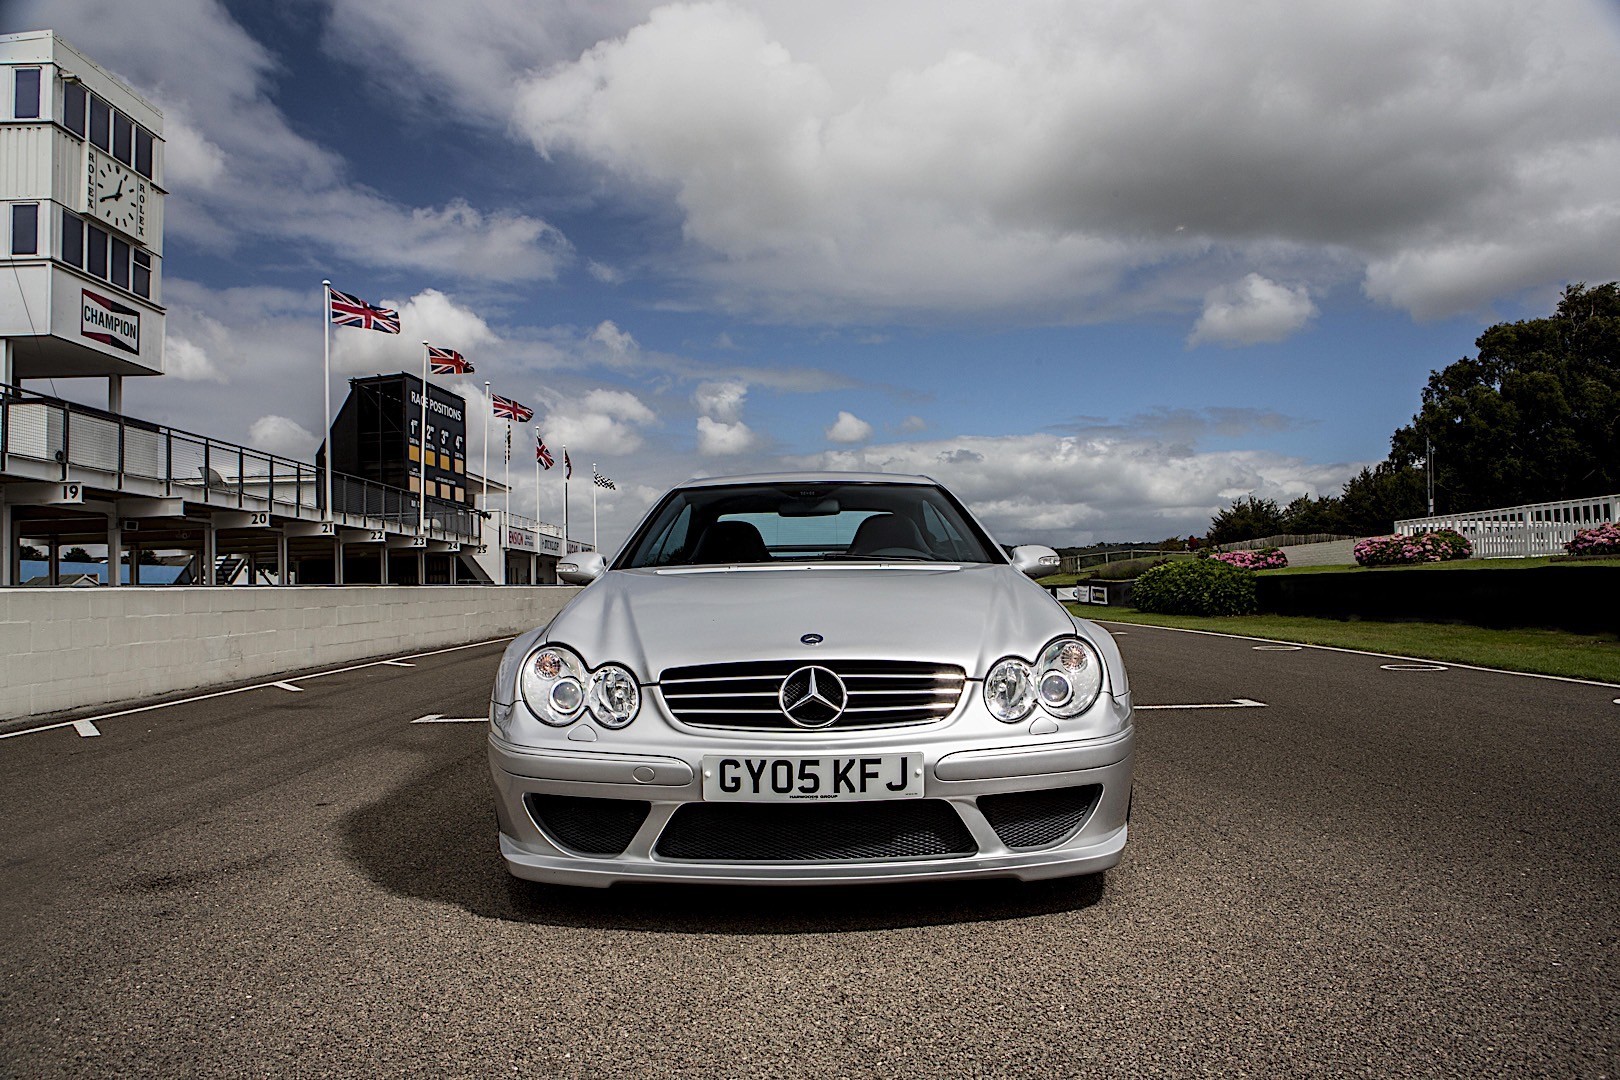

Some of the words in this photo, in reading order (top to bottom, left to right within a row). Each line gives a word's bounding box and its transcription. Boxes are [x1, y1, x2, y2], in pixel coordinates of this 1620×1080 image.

[84, 305, 137, 340] CHAMPION
[429, 399, 462, 421] POSITIONS
[63, 485, 79, 499] 19
[251, 513, 267, 525] 20
[322, 523, 333, 533] 21
[370, 531, 384, 540] 22
[413, 537, 425, 546] 23
[477, 546, 487, 554] 25
[719, 758, 820, 794] GY05
[833, 756, 908, 794] KFJ
